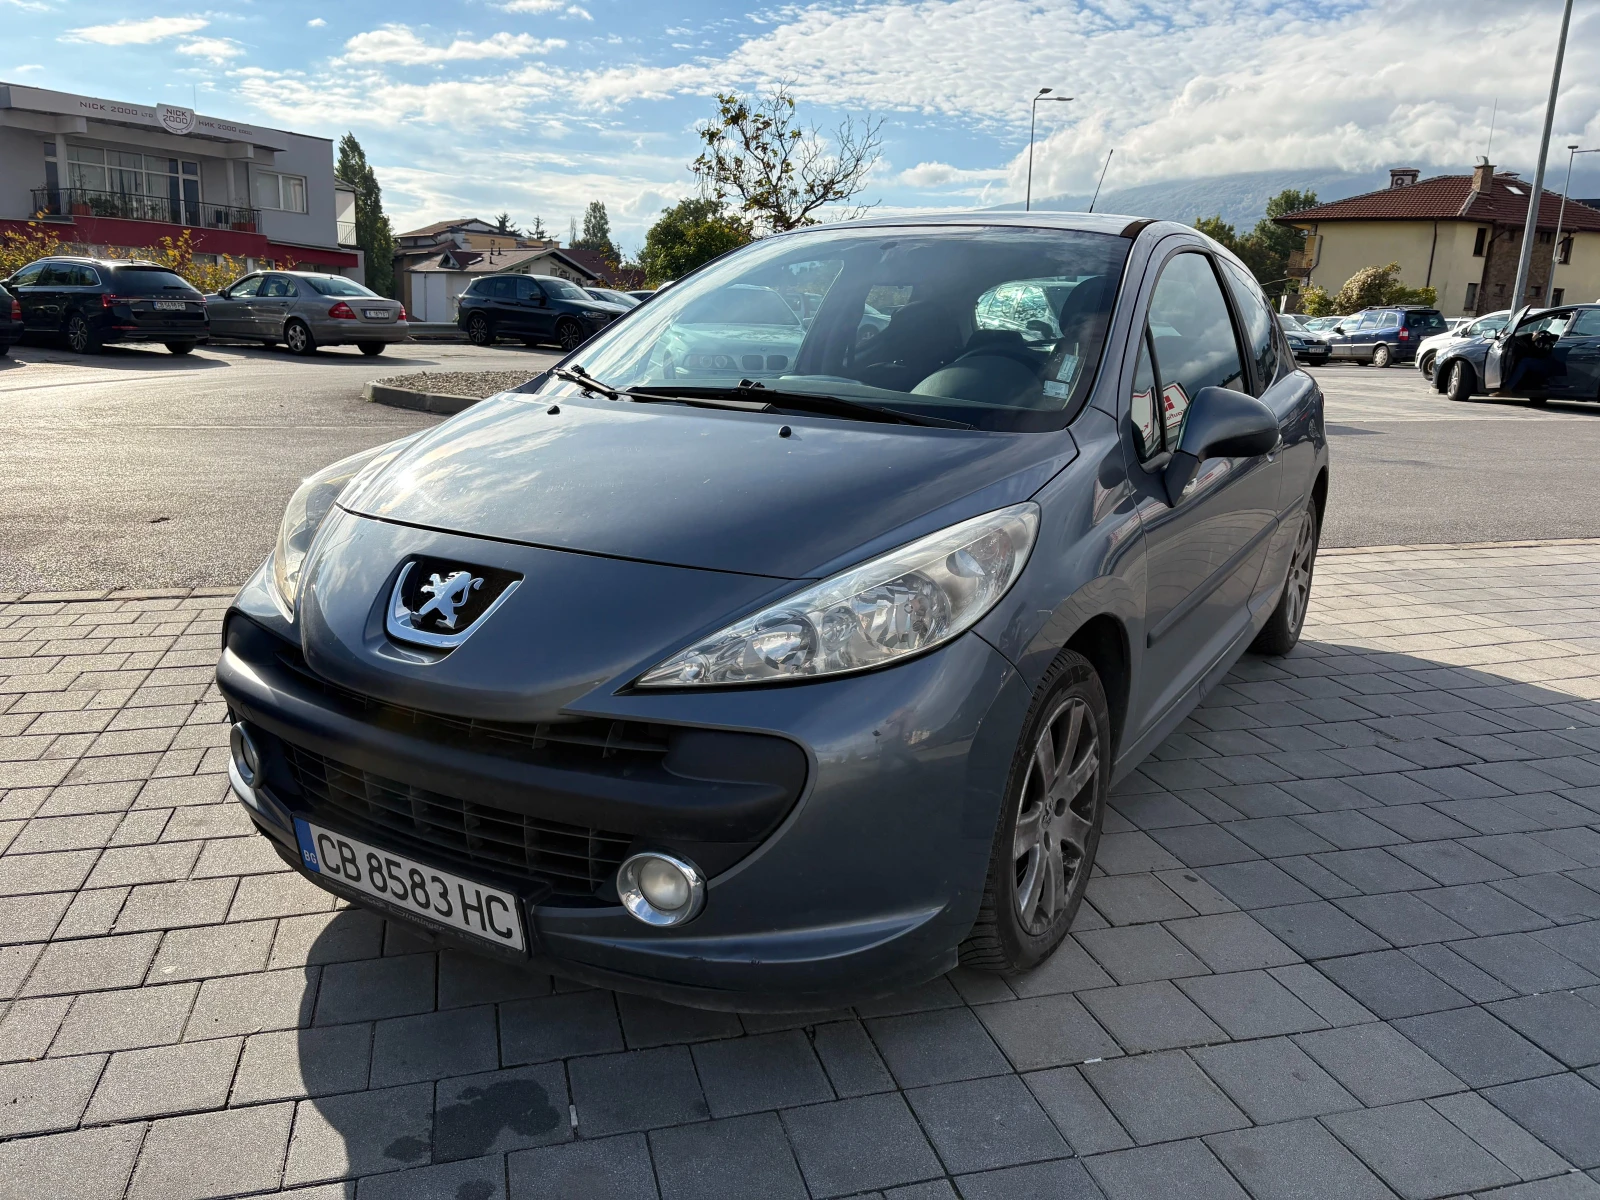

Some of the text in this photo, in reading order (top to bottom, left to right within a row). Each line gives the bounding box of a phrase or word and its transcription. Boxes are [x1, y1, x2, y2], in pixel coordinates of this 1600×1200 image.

[79, 101, 107, 111] NICK
[110, 106, 138, 116] 2000
[166, 108, 187, 118] NICK
[163, 114, 188, 124] 2000
[198, 120, 215, 129] НИК
[218, 124, 237, 133] 2000
[303, 850, 317, 864] BG
[317, 833, 362, 883] CB
[366, 852, 454, 918] 8583
[457, 883, 513, 939] HC
